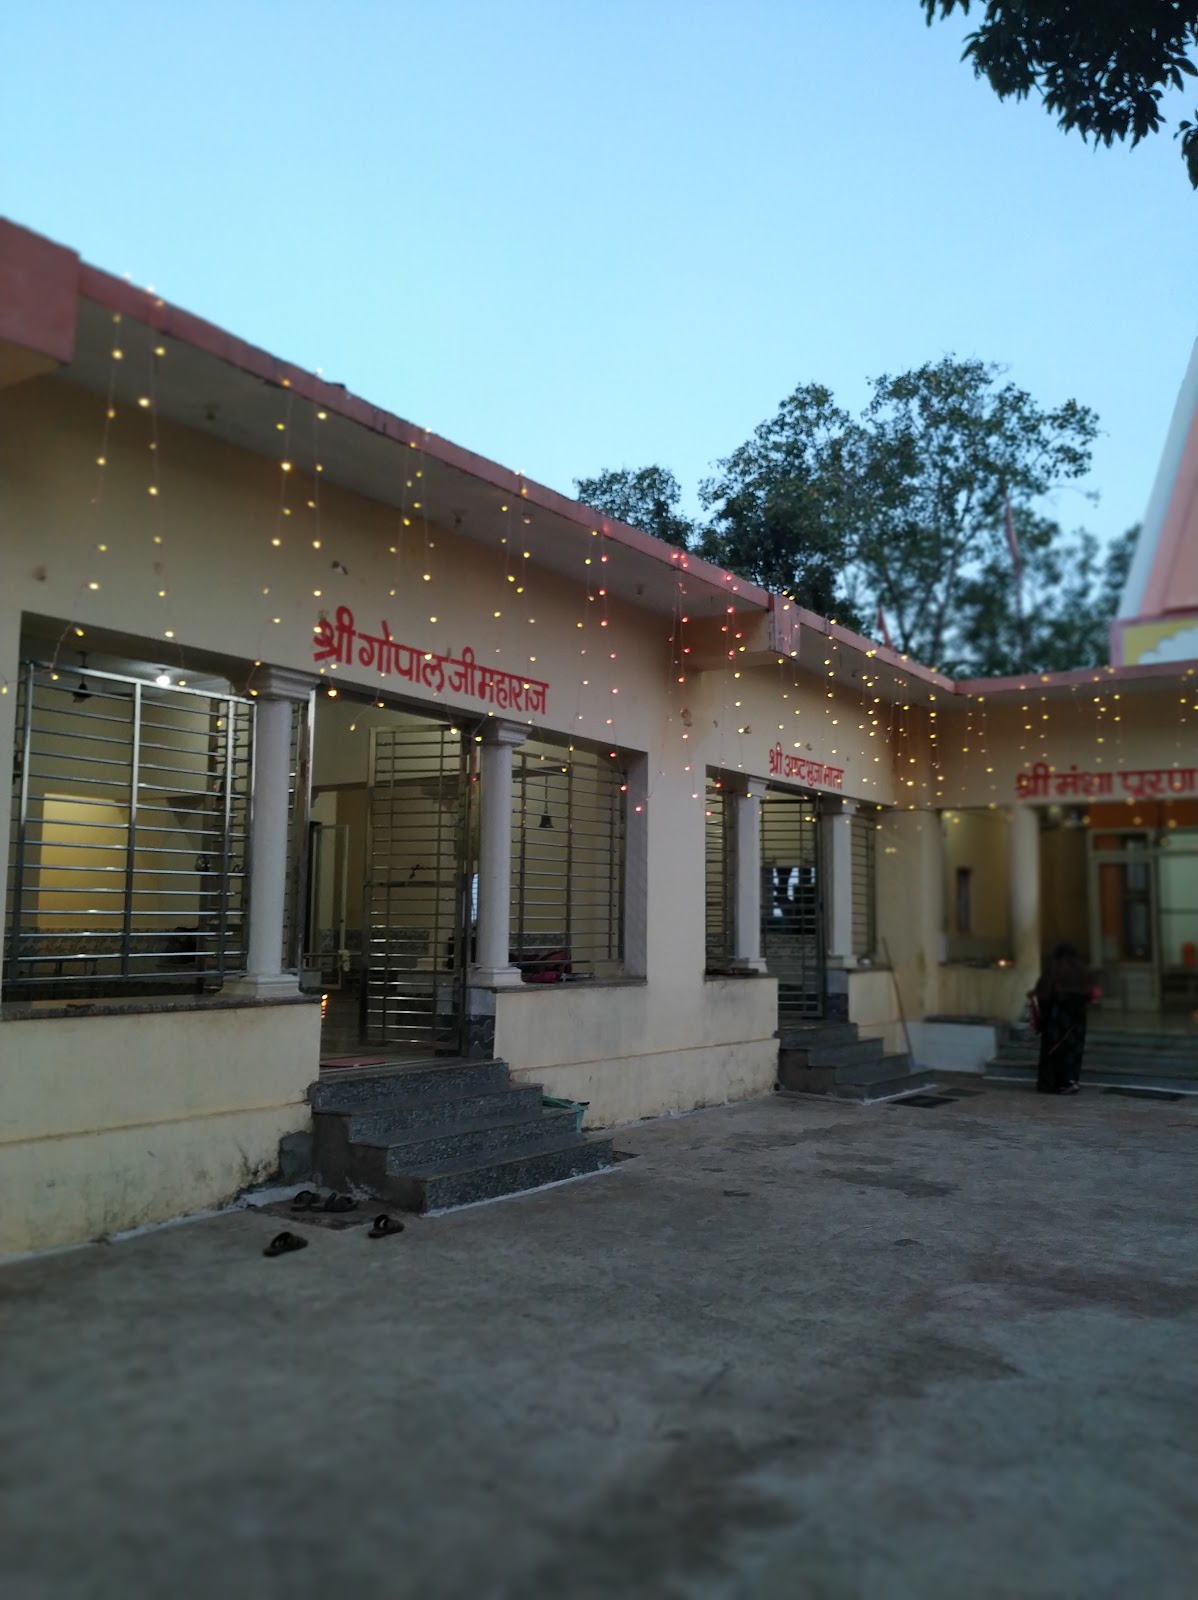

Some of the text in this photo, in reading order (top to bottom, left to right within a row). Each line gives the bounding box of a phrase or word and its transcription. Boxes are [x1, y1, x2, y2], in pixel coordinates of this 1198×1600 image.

[313, 605, 356, 665] श्री
[769, 741, 783, 774] श्री
[1015, 762, 1050, 799] श्री
